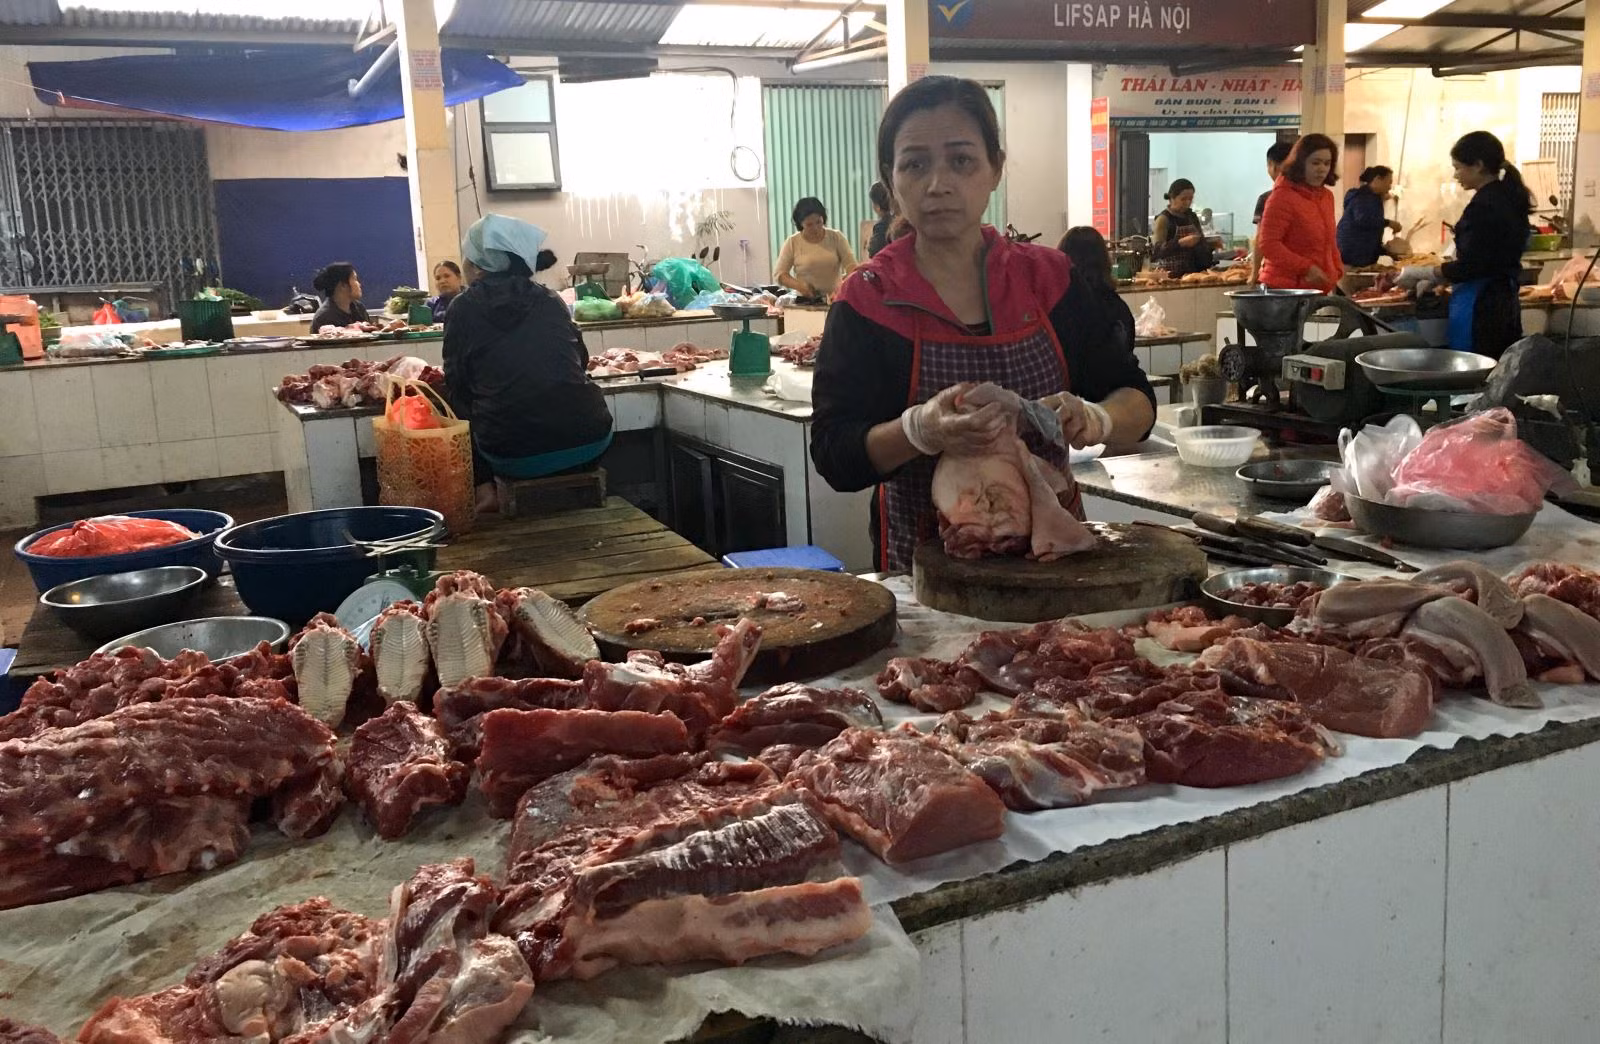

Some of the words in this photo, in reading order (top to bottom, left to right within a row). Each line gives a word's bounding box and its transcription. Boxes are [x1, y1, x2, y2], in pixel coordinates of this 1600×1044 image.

[1054, 3, 1121, 27] LIFSAP
[1128, 1, 1153, 28] HÀ
[1160, 3, 1190, 34] NỘI
[1121, 74, 1167, 92] THÁI
[1169, 78, 1209, 92] LAN
[1220, 75, 1271, 95] NHẬT
